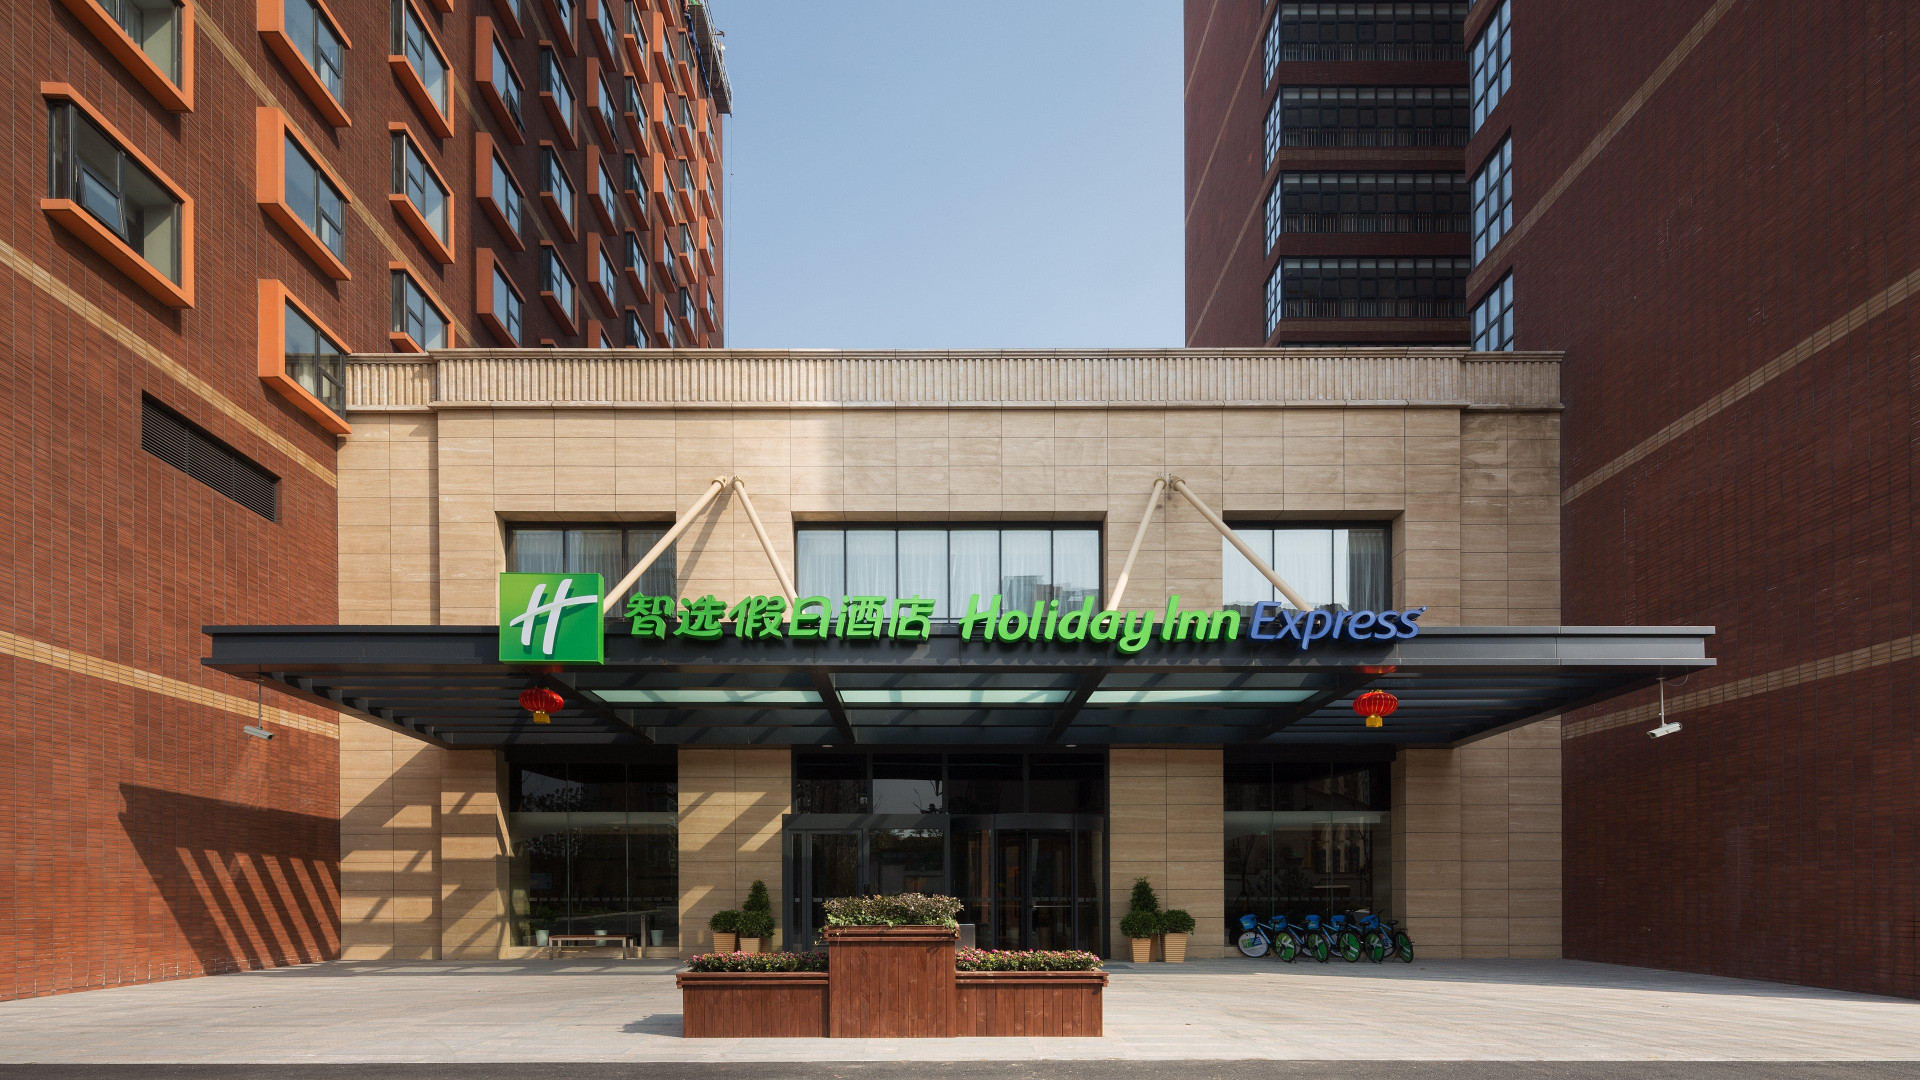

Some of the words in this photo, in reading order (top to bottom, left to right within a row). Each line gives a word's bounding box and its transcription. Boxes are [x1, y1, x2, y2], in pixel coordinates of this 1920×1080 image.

[623, 592, 936, 641] 智选假日酒店
[958, 593, 1153, 655] Holiday
[1159, 593, 1242, 643] Inn
[1249, 600, 1421, 651] Express
